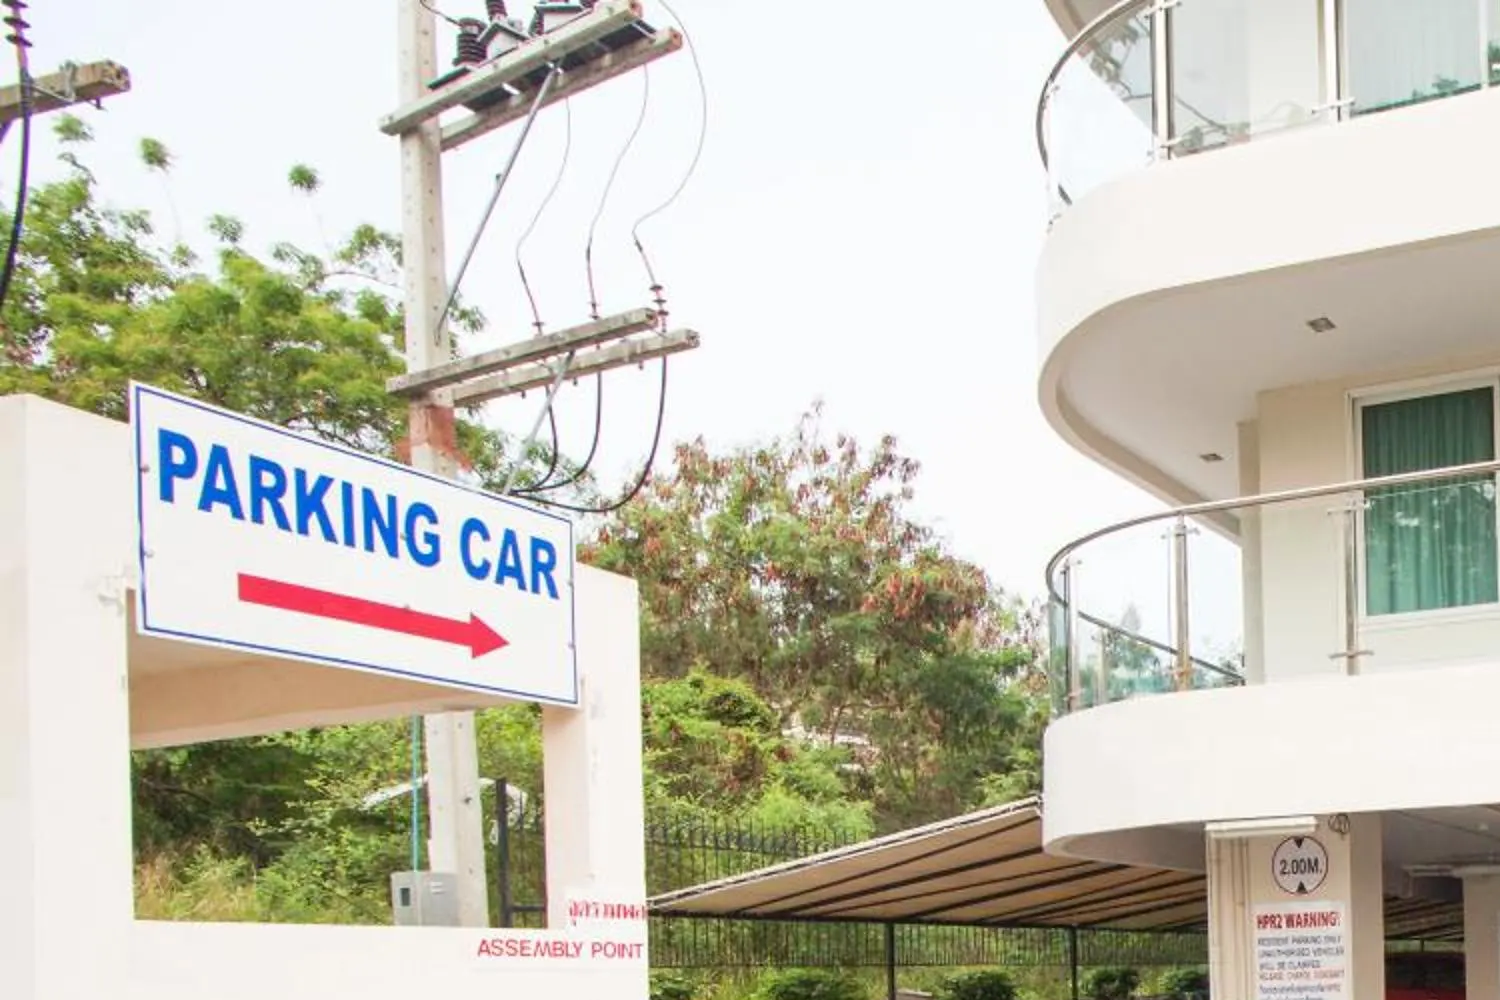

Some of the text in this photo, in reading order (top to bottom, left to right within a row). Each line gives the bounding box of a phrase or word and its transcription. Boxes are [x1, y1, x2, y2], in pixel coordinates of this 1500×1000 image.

[157, 426, 561, 600] PARKING CAR
[1279, 857, 1323, 875] 2.00M.
[477, 938, 645, 960] ASSEMBLY POINT
